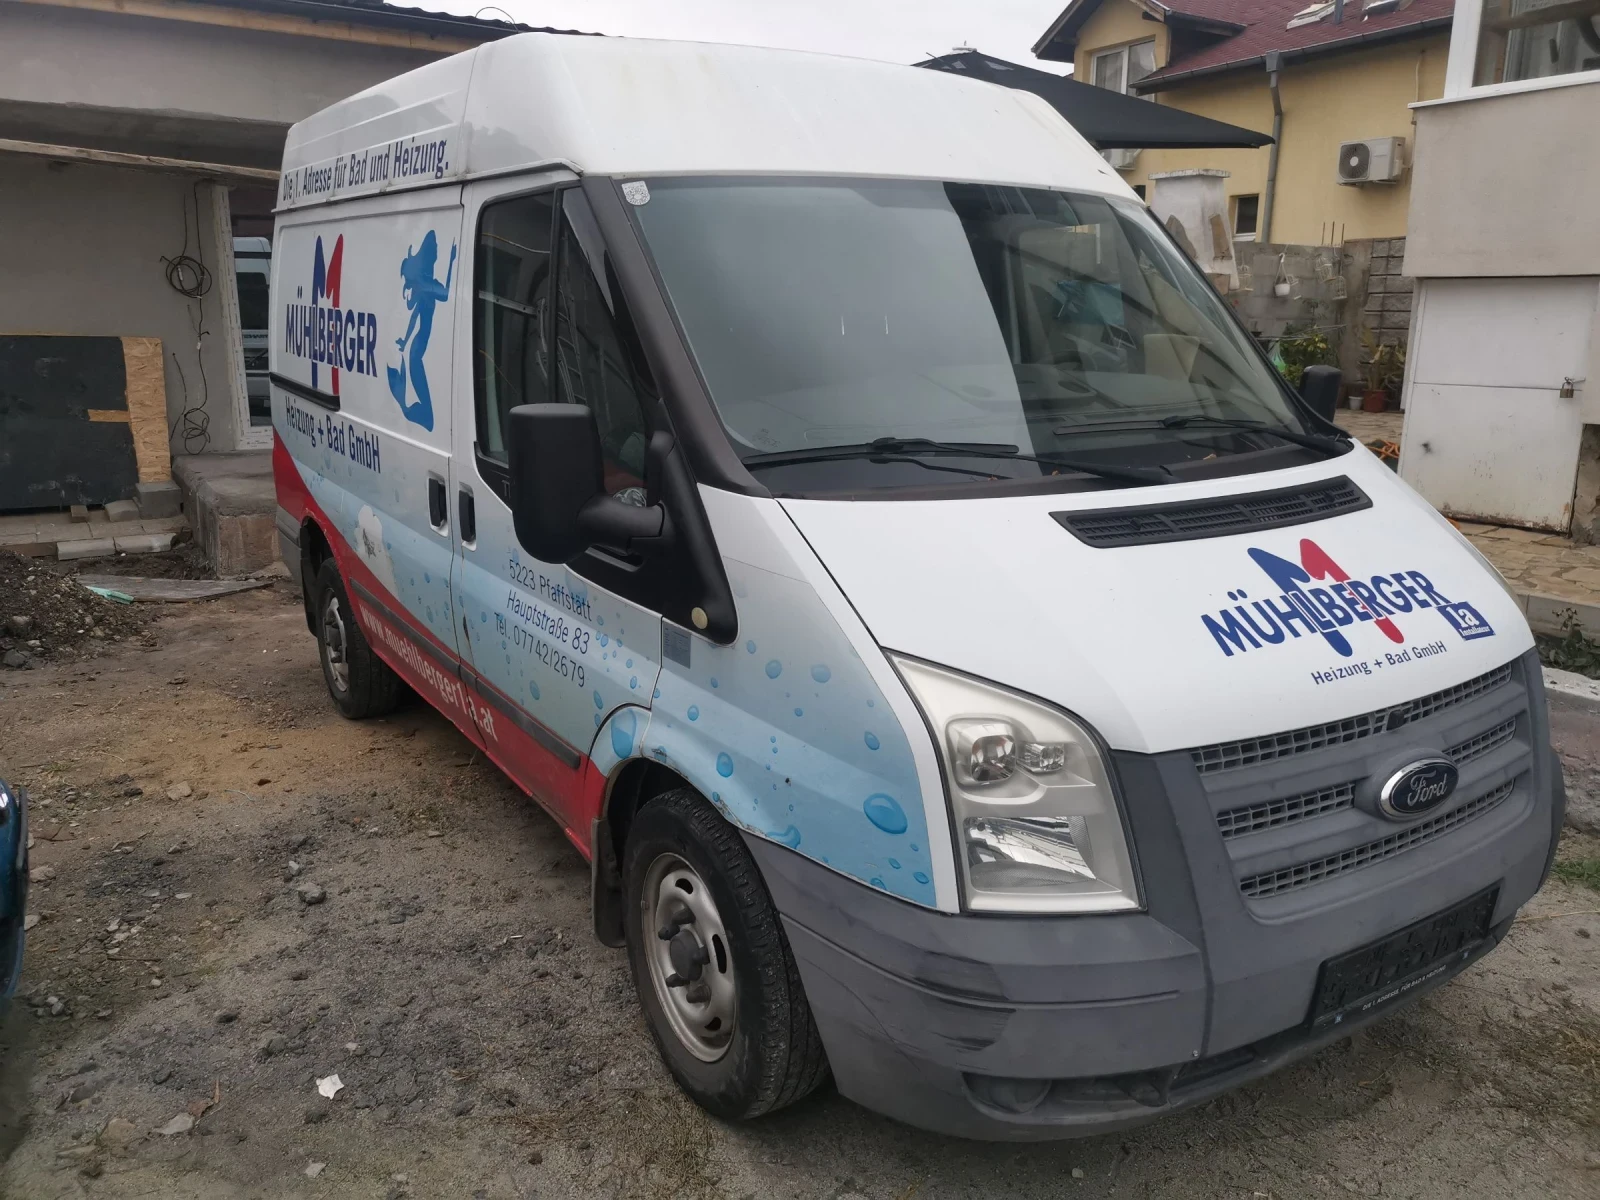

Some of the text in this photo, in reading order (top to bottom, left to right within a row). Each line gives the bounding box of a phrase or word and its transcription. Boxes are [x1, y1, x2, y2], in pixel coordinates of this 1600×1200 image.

[283, 174, 293, 201] Die
[302, 165, 332, 197] Adresse
[333, 156, 347, 189] für
[349, 150, 368, 187] Bad
[369, 145, 391, 183] und
[393, 136, 449, 180] Heizung.
[285, 286, 378, 378] MÜHLBERGER
[285, 395, 317, 448] Heizung
[317, 418, 325, 444] +
[325, 414, 346, 453] Bad
[348, 424, 381, 474] GmbH
[507, 589, 590, 655] Hauptstraße 83
[509, 558, 592, 622] 5223 Pfaffstätt
[1200, 570, 1453, 657] MÜHLBERGER
[1445, 606, 1480, 628] 1a
[358, 601, 498, 742] www.muehlberger1a.at
[494, 611, 585, 688] Tel. 07742/2679
[1311, 640, 1448, 685] Heizung + Bad GmbH
[1407, 770, 1448, 807] Ford
